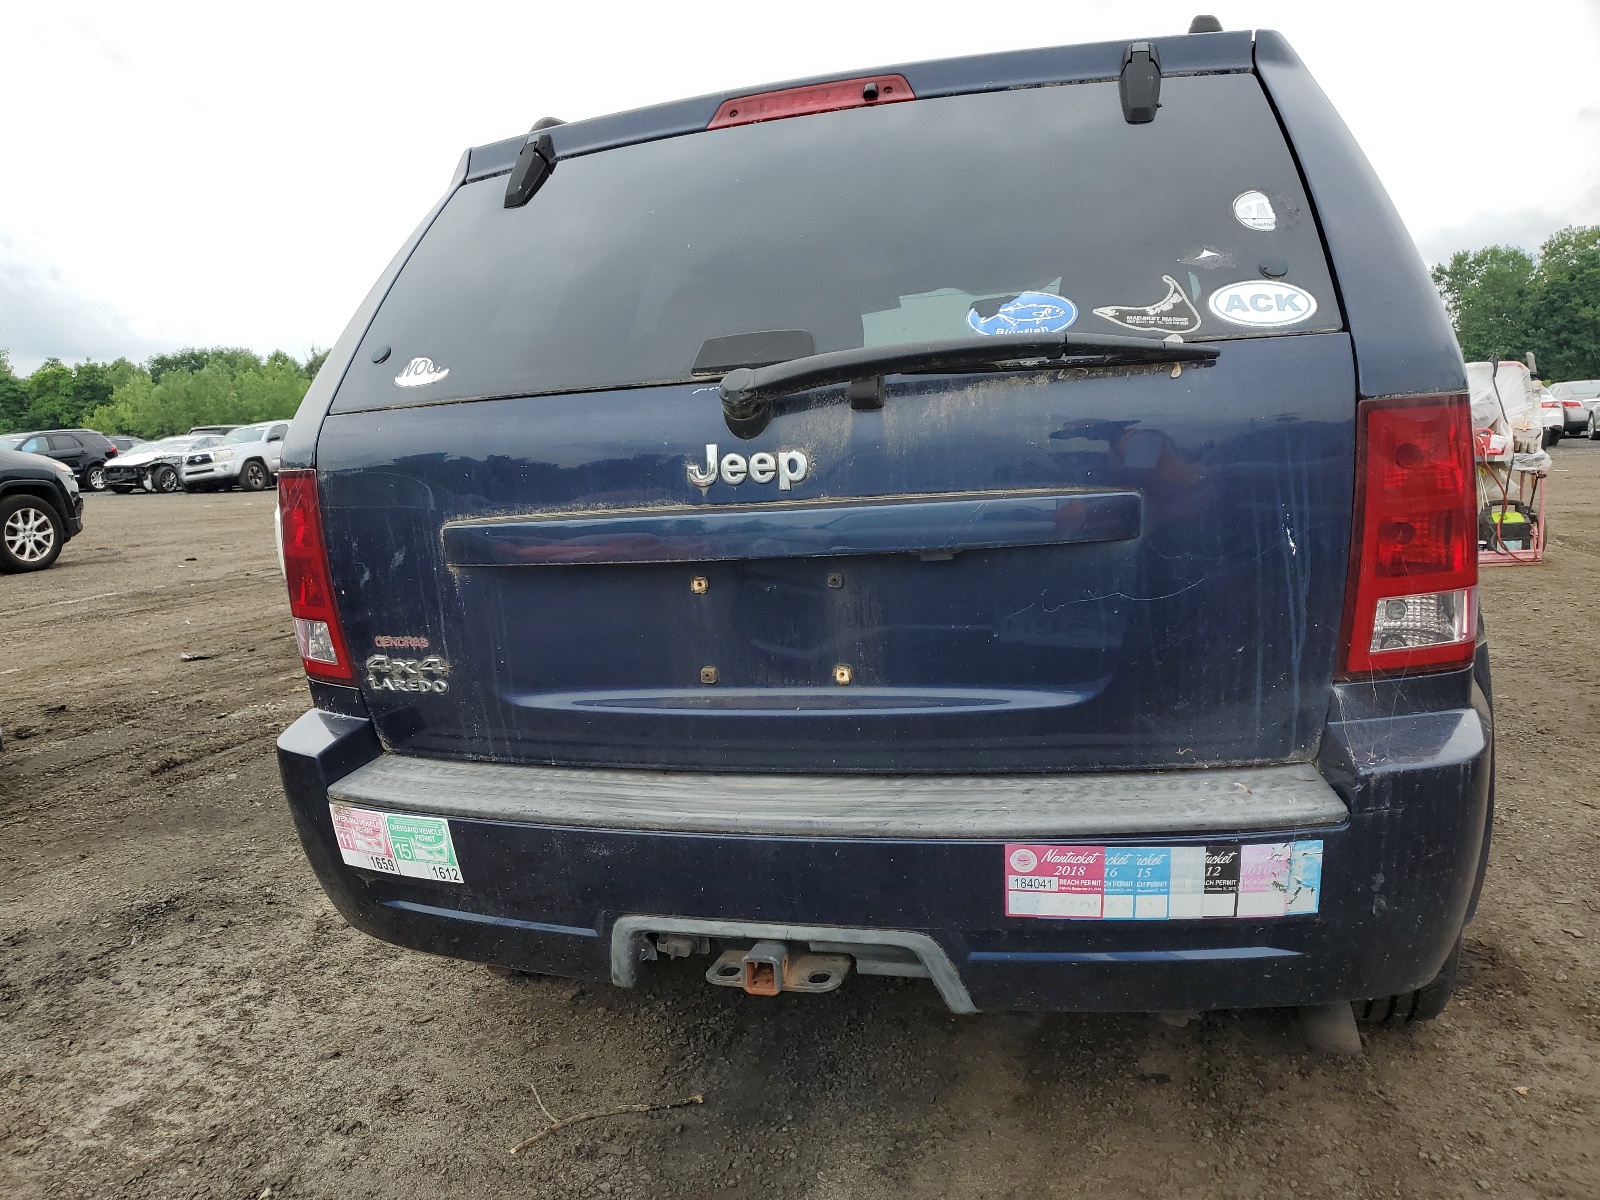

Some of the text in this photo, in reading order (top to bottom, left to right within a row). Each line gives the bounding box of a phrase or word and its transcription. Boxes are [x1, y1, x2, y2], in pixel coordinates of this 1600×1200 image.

[1224, 293, 1303, 313] ACK
[686, 443, 808, 491] Jeep
[367, 675, 450, 694] LAREDO
[340, 832, 354, 849] 11
[414, 834, 436, 843] PERMIT
[395, 842, 412, 860] 15
[1041, 848, 1102, 864] Nantucket
[370, 856, 396, 872] 1659
[1053, 865, 1086, 876] 2018
[1205, 866, 1222, 877] 12
[432, 865, 460, 881] 1612
[1014, 877, 1053, 890] 184041
[1059, 878, 1079, 886] BEACH
